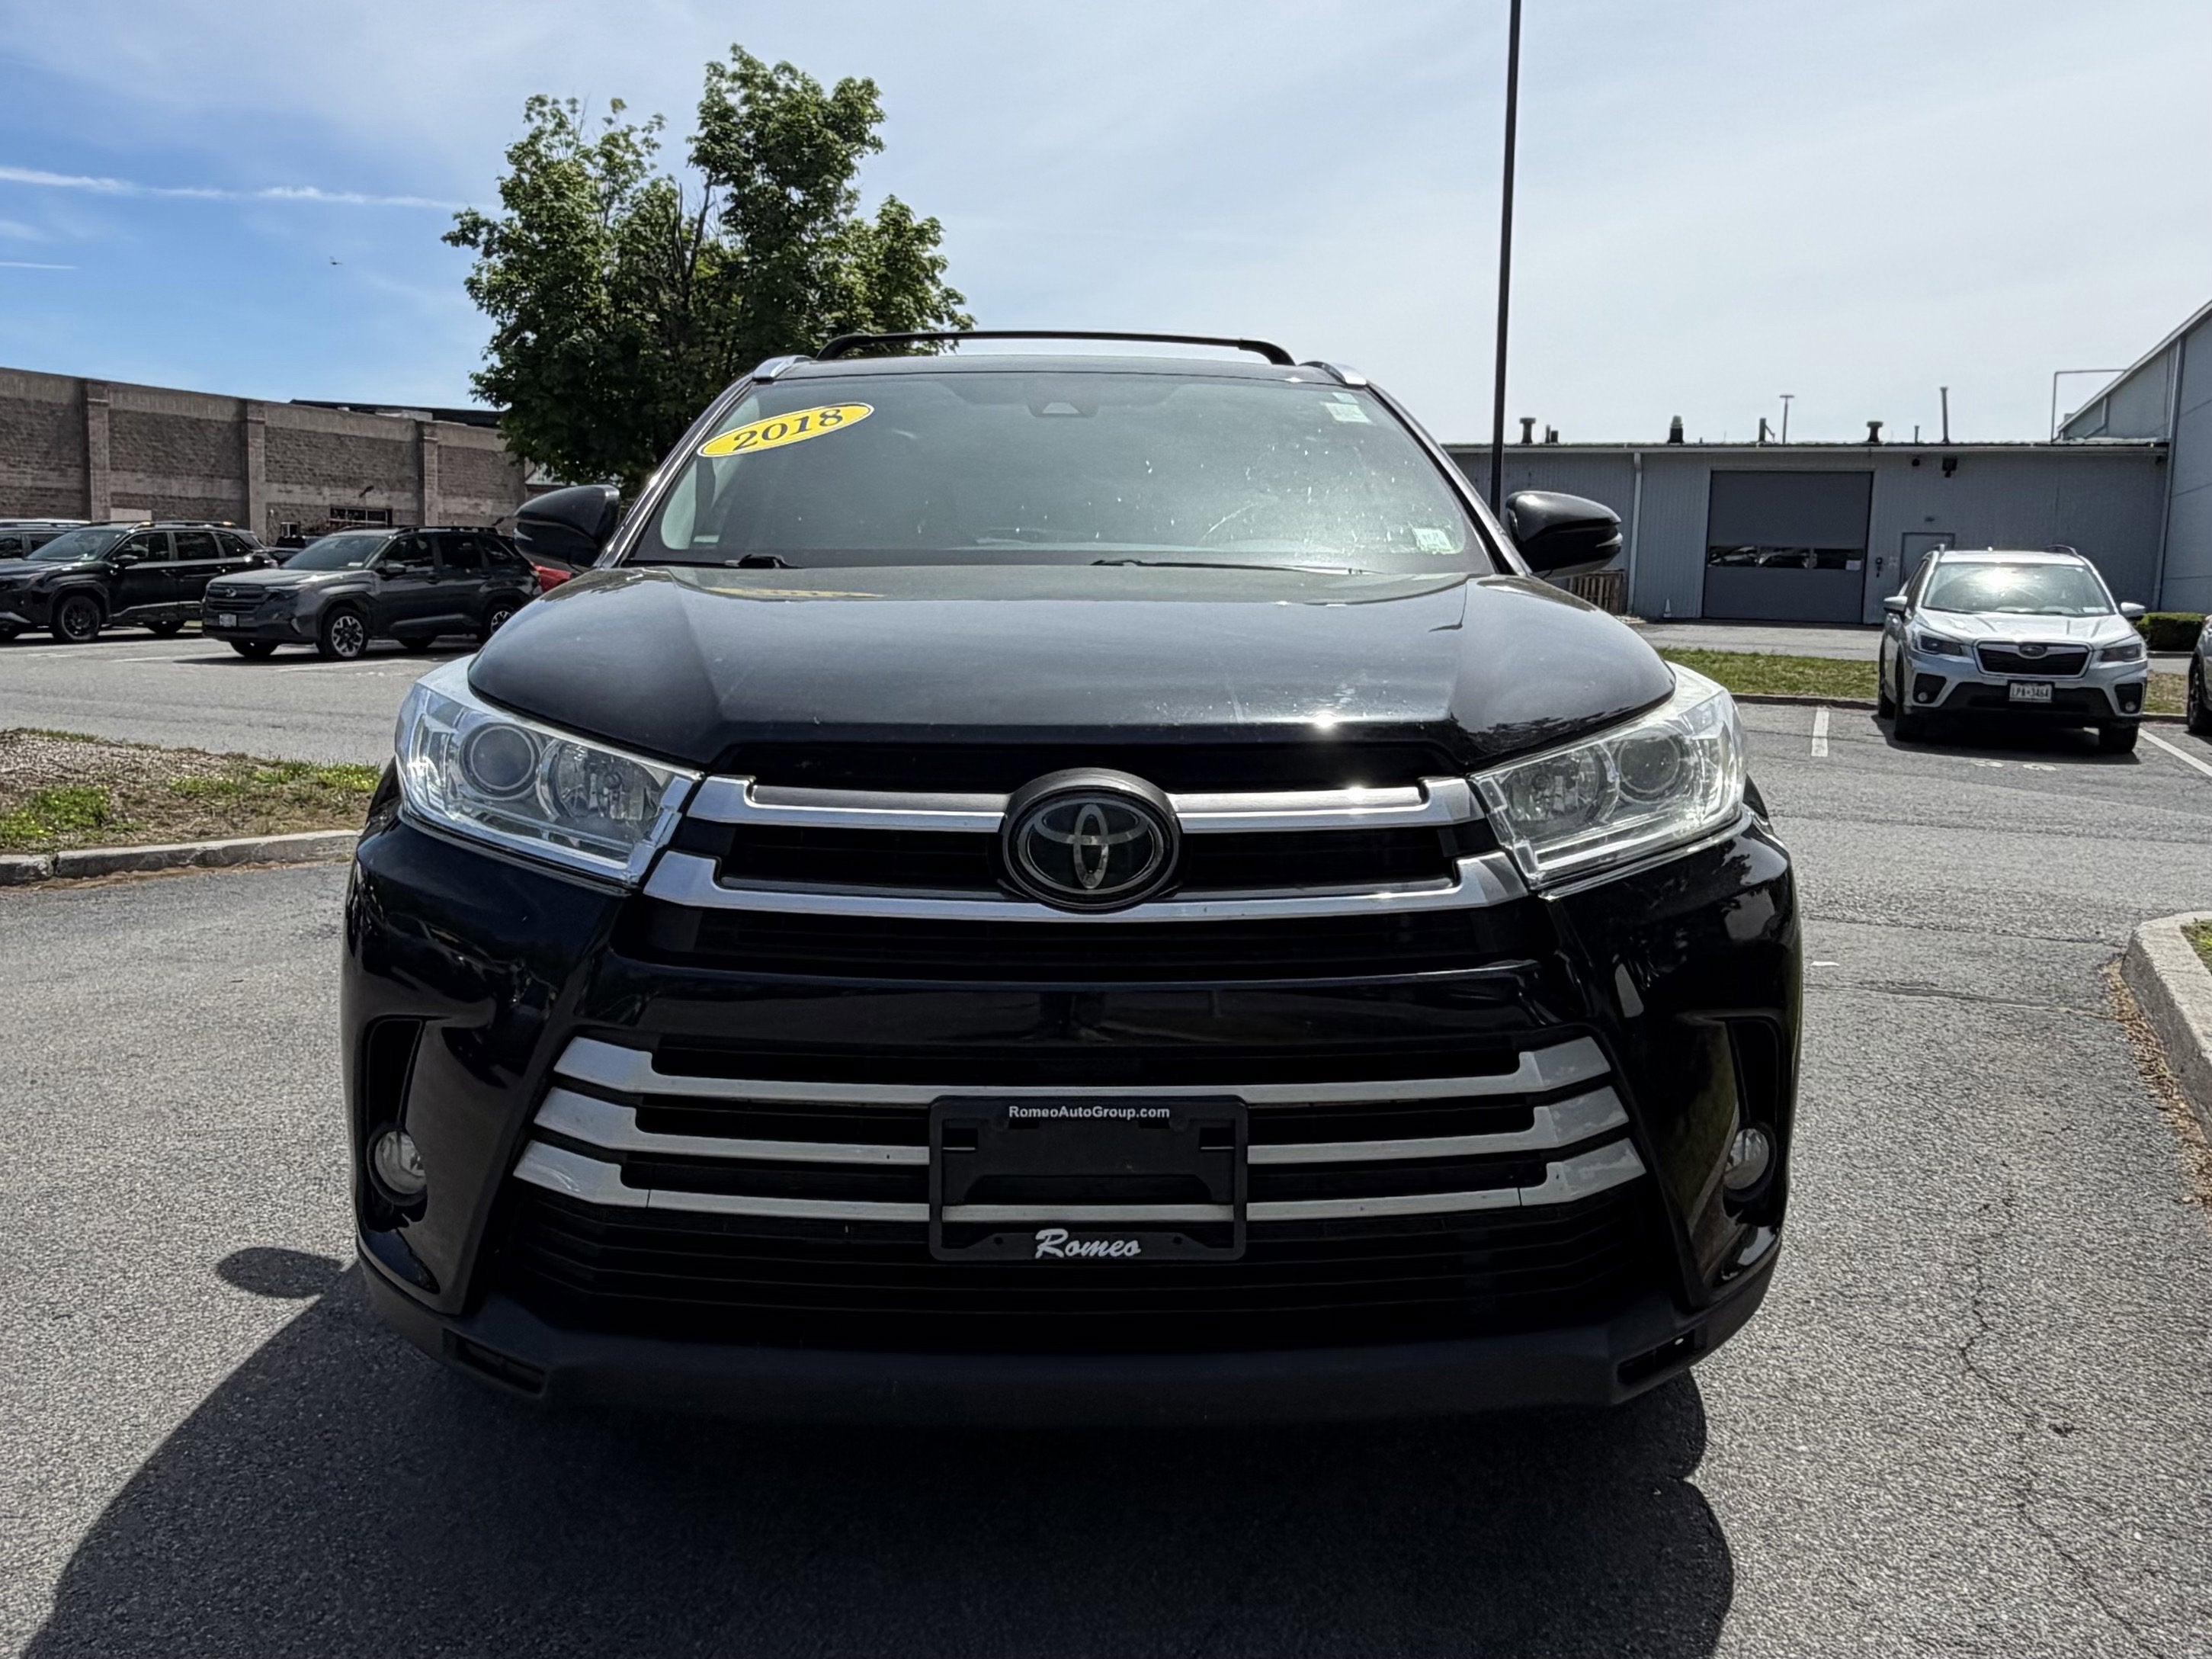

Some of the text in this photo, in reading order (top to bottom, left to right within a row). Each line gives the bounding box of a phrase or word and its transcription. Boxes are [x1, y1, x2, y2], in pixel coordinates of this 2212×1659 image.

[733, 409, 843, 451] 2018
[1009, 1105, 1170, 1120] RomeoAutoGroup.com
[1035, 1228, 1141, 1259] Romeo
